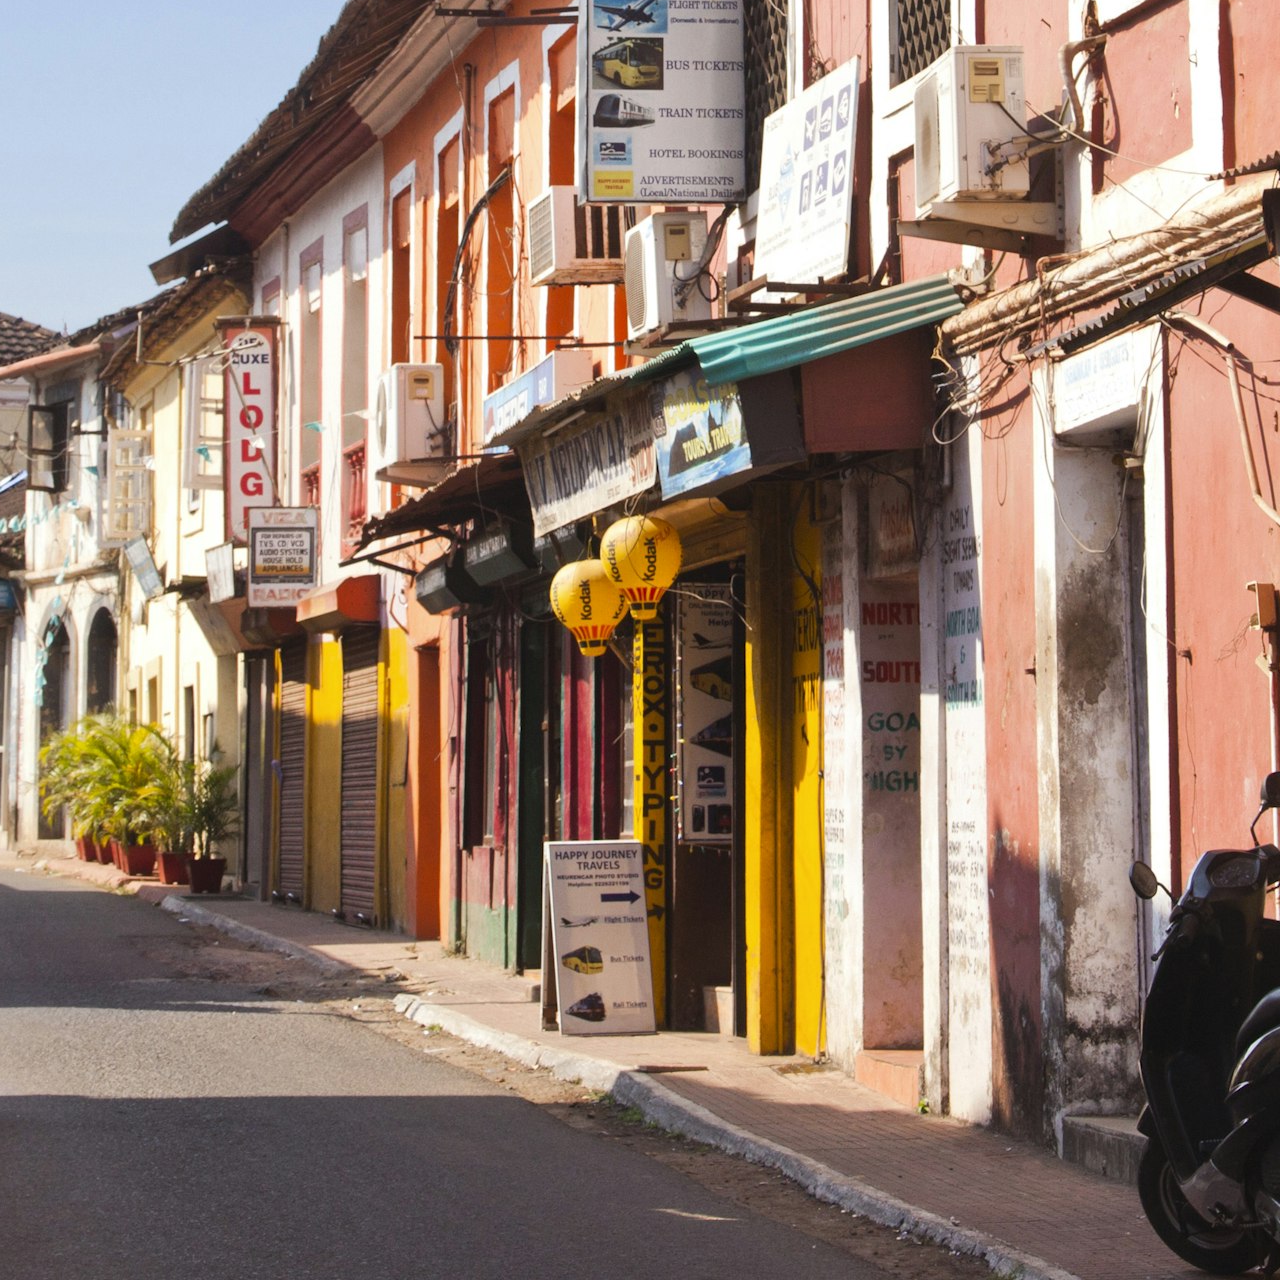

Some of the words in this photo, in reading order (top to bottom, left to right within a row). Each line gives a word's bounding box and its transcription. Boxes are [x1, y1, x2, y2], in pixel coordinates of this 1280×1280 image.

[669, 0, 700, 10] FLIGHT
[702, 0, 738, 10] TICKETS
[666, 60, 690, 70] BUS
[694, 60, 744, 71] TICKETS
[658, 108, 693, 118] TRAIN
[696, 108, 744, 119] TICKETS
[649, 149, 686, 159] HOTEL
[688, 149, 744, 159] BOOKINGS
[639, 176, 735, 185] ADVERTISEMENTS
[238, 371, 264, 530] LODG
[682, 435, 707, 463] TOURS
[950, 506, 970, 532] DAILY
[259, 548, 276, 556] AUDIO
[277, 548, 309, 556] SYSTEMS
[262, 556, 283, 564] HOUSE
[285, 556, 304, 564] HOLD
[608, 538, 623, 583] Kodak
[642, 535, 658, 582] Kodak
[261, 565, 304, 573] APPLIANCES
[579, 578, 592, 620] Kodak
[642, 620, 666, 716] EROX
[867, 712, 921, 732] GOA
[884, 745, 908, 761] BY
[642, 739, 666, 890] TYPING
[555, 851, 590, 861] HAPPY
[591, 849, 638, 860] JOURNEY
[577, 861, 621, 871] TRAVELS
[604, 916, 622, 924] Flight
[623, 915, 645, 923] Tickets
[610, 955, 622, 963] Bus
[624, 955, 645, 963] Tickets
[612, 1001, 625, 1009] Rail
[626, 1000, 648, 1009] Tickets
